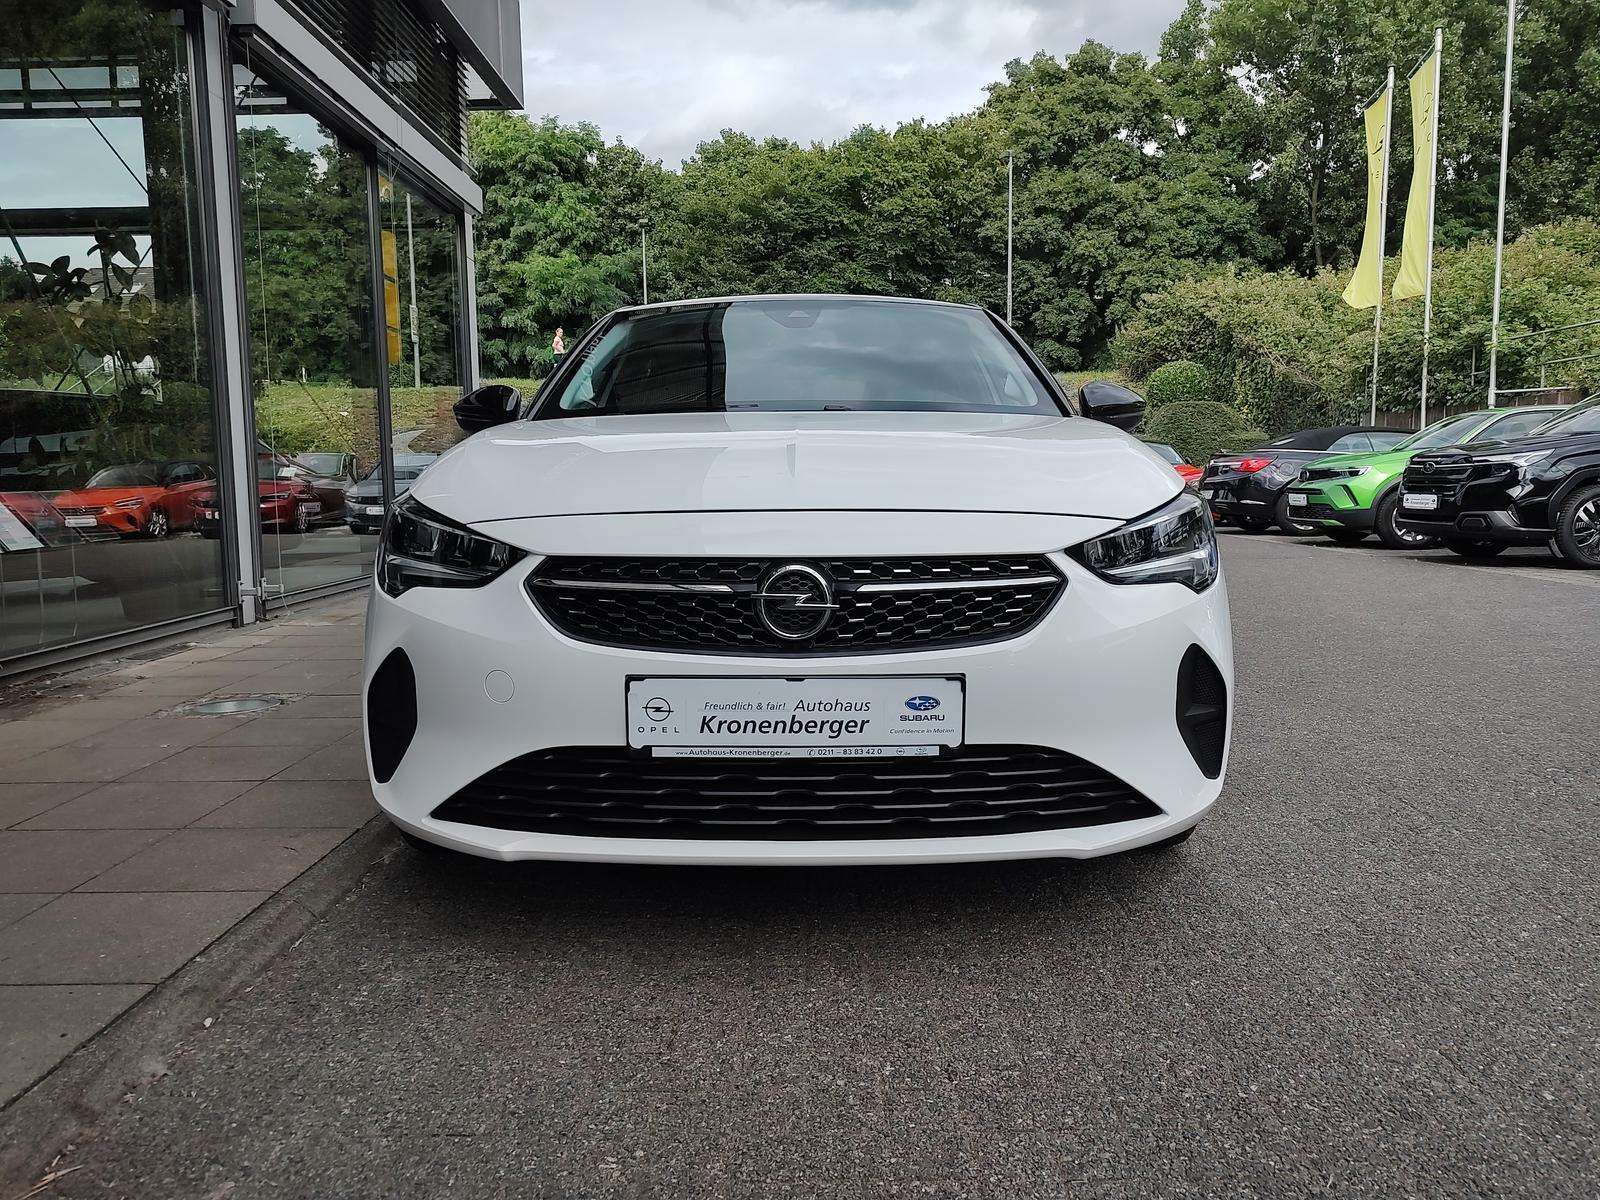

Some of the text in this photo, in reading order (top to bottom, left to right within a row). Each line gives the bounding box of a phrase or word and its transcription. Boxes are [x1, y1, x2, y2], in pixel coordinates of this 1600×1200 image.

[704, 698, 871, 712] Freundlich & fair! Autohaus
[899, 714, 945, 722] SUBARU
[637, 726, 680, 734] OPEL
[699, 714, 871, 739] Kronenberger
[817, 748, 834, 756] 0211
